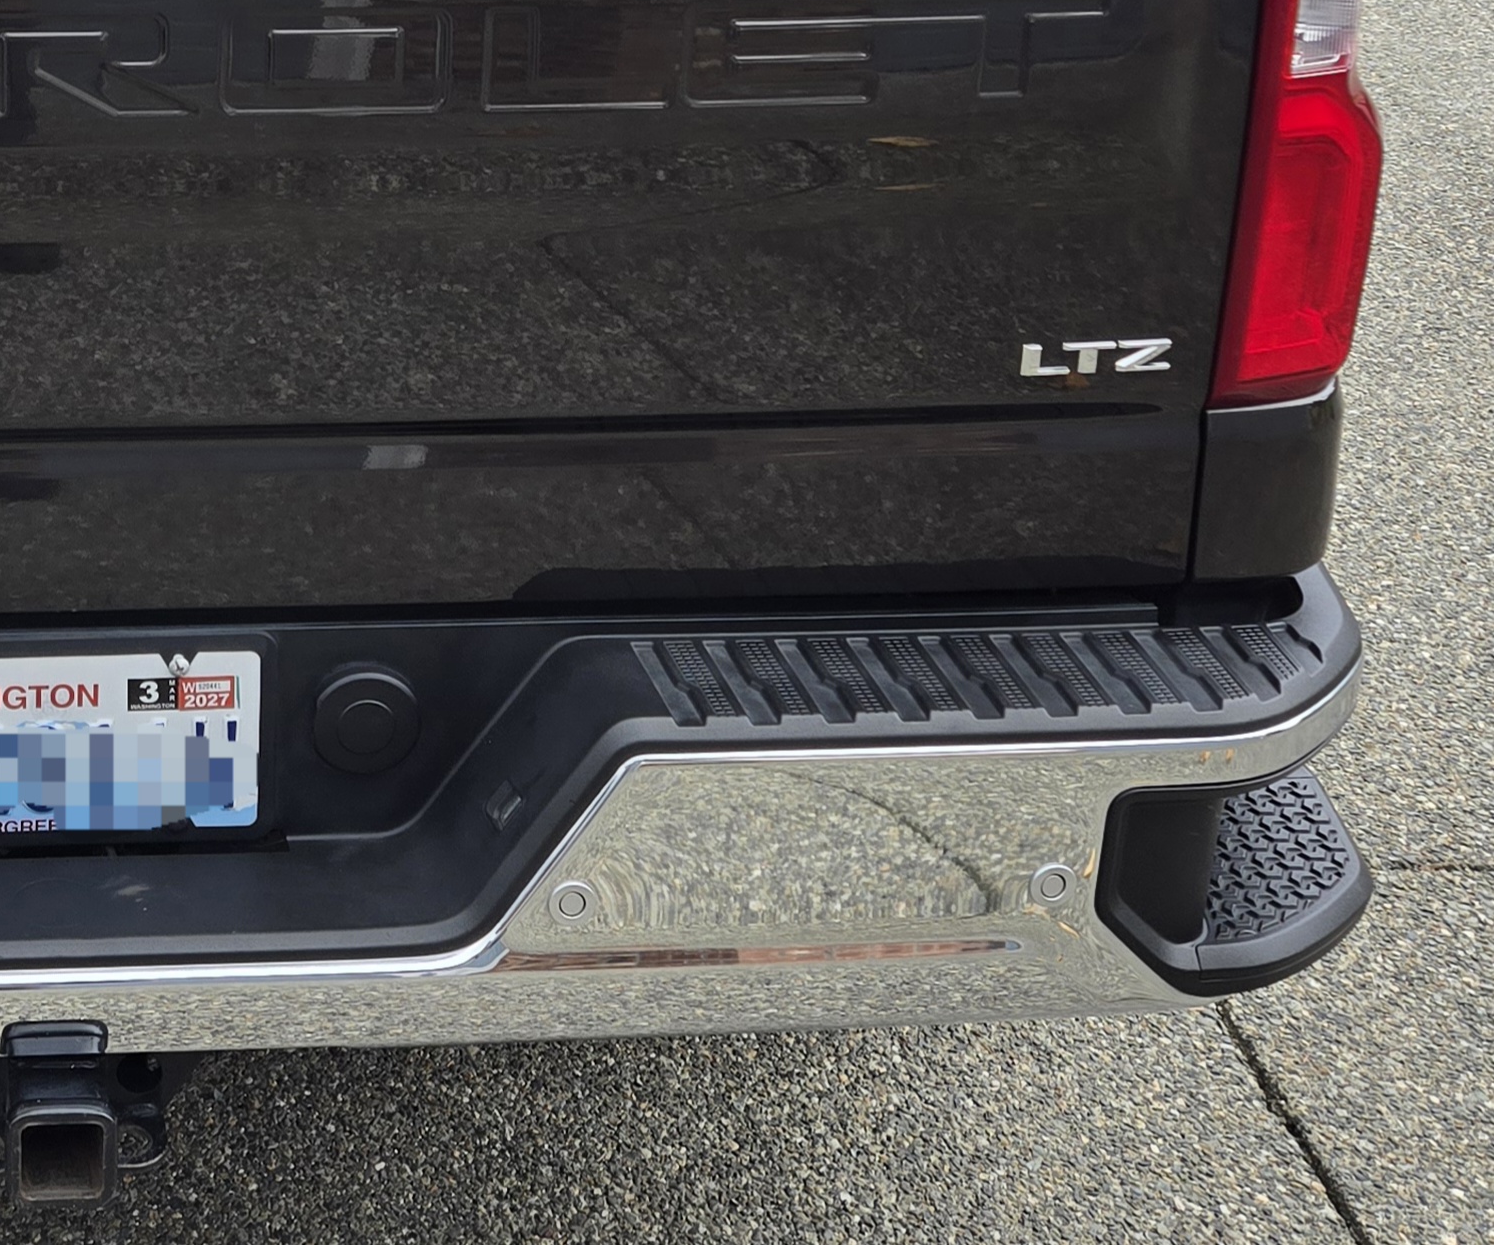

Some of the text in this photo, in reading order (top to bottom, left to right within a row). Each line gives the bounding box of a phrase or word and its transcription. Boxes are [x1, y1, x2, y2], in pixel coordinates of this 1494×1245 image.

[1020, 338, 1173, 377] LTZ
[138, 681, 159, 704] 3
[168, 679, 176, 702] MAR
[182, 682, 196, 694] W
[130, 702, 176, 710] WASHINGTON
[184, 693, 229, 708] 2027
